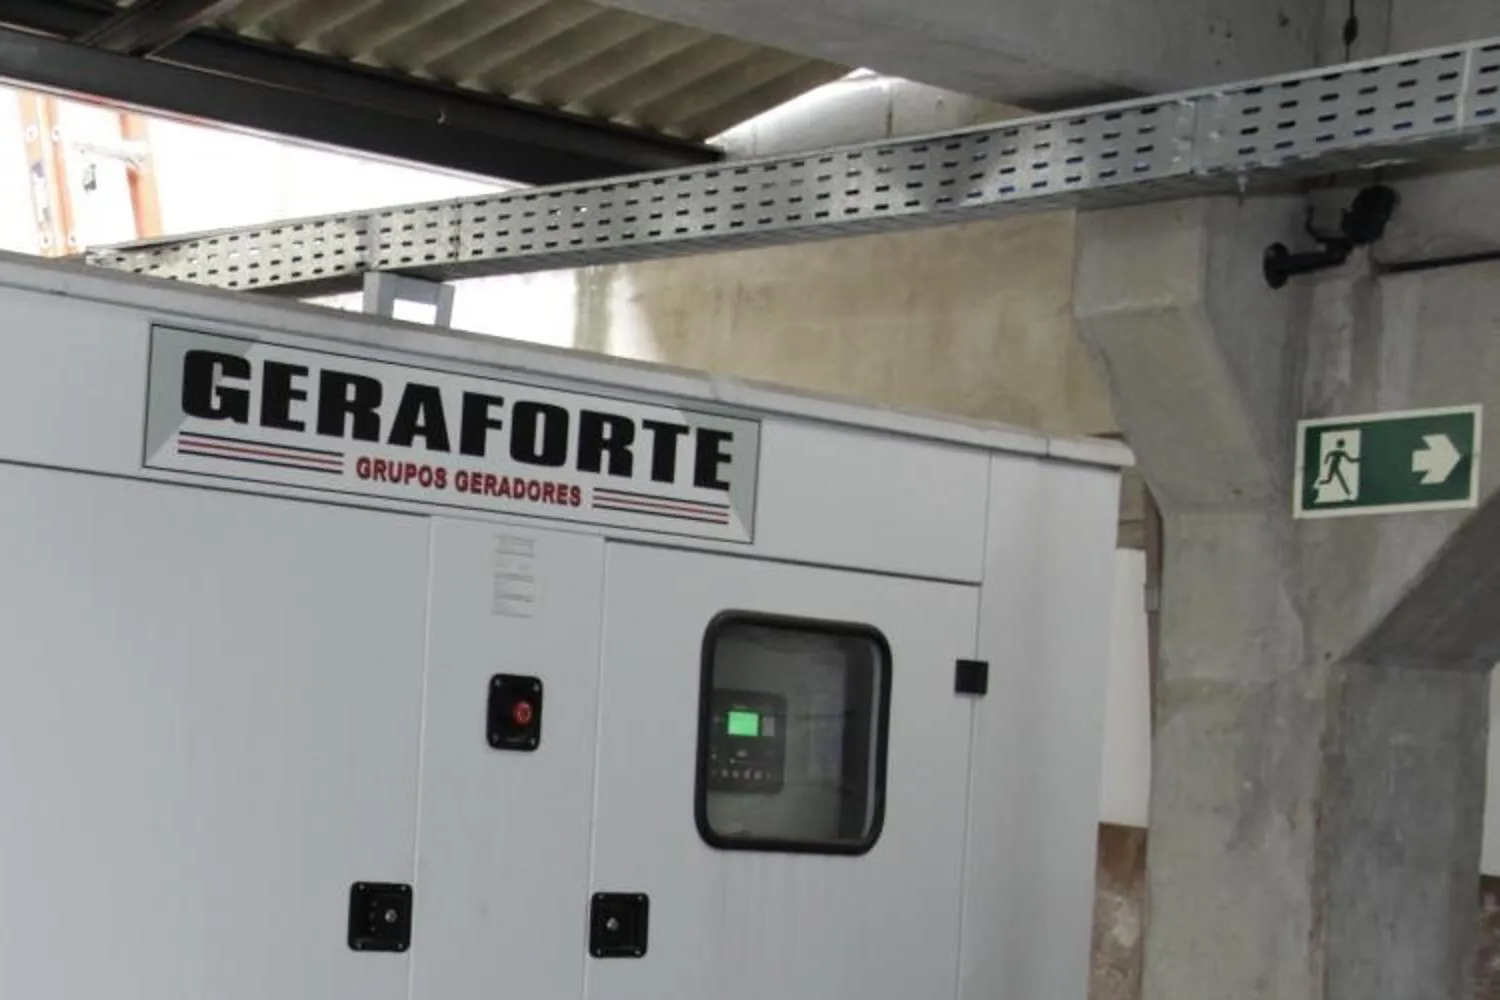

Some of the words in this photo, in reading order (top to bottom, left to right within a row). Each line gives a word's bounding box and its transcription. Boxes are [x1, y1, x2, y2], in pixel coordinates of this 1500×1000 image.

[181, 348, 734, 492] GERAFORTE
[355, 456, 448, 490] GRUPOS
[454, 470, 582, 508] GERADORES
